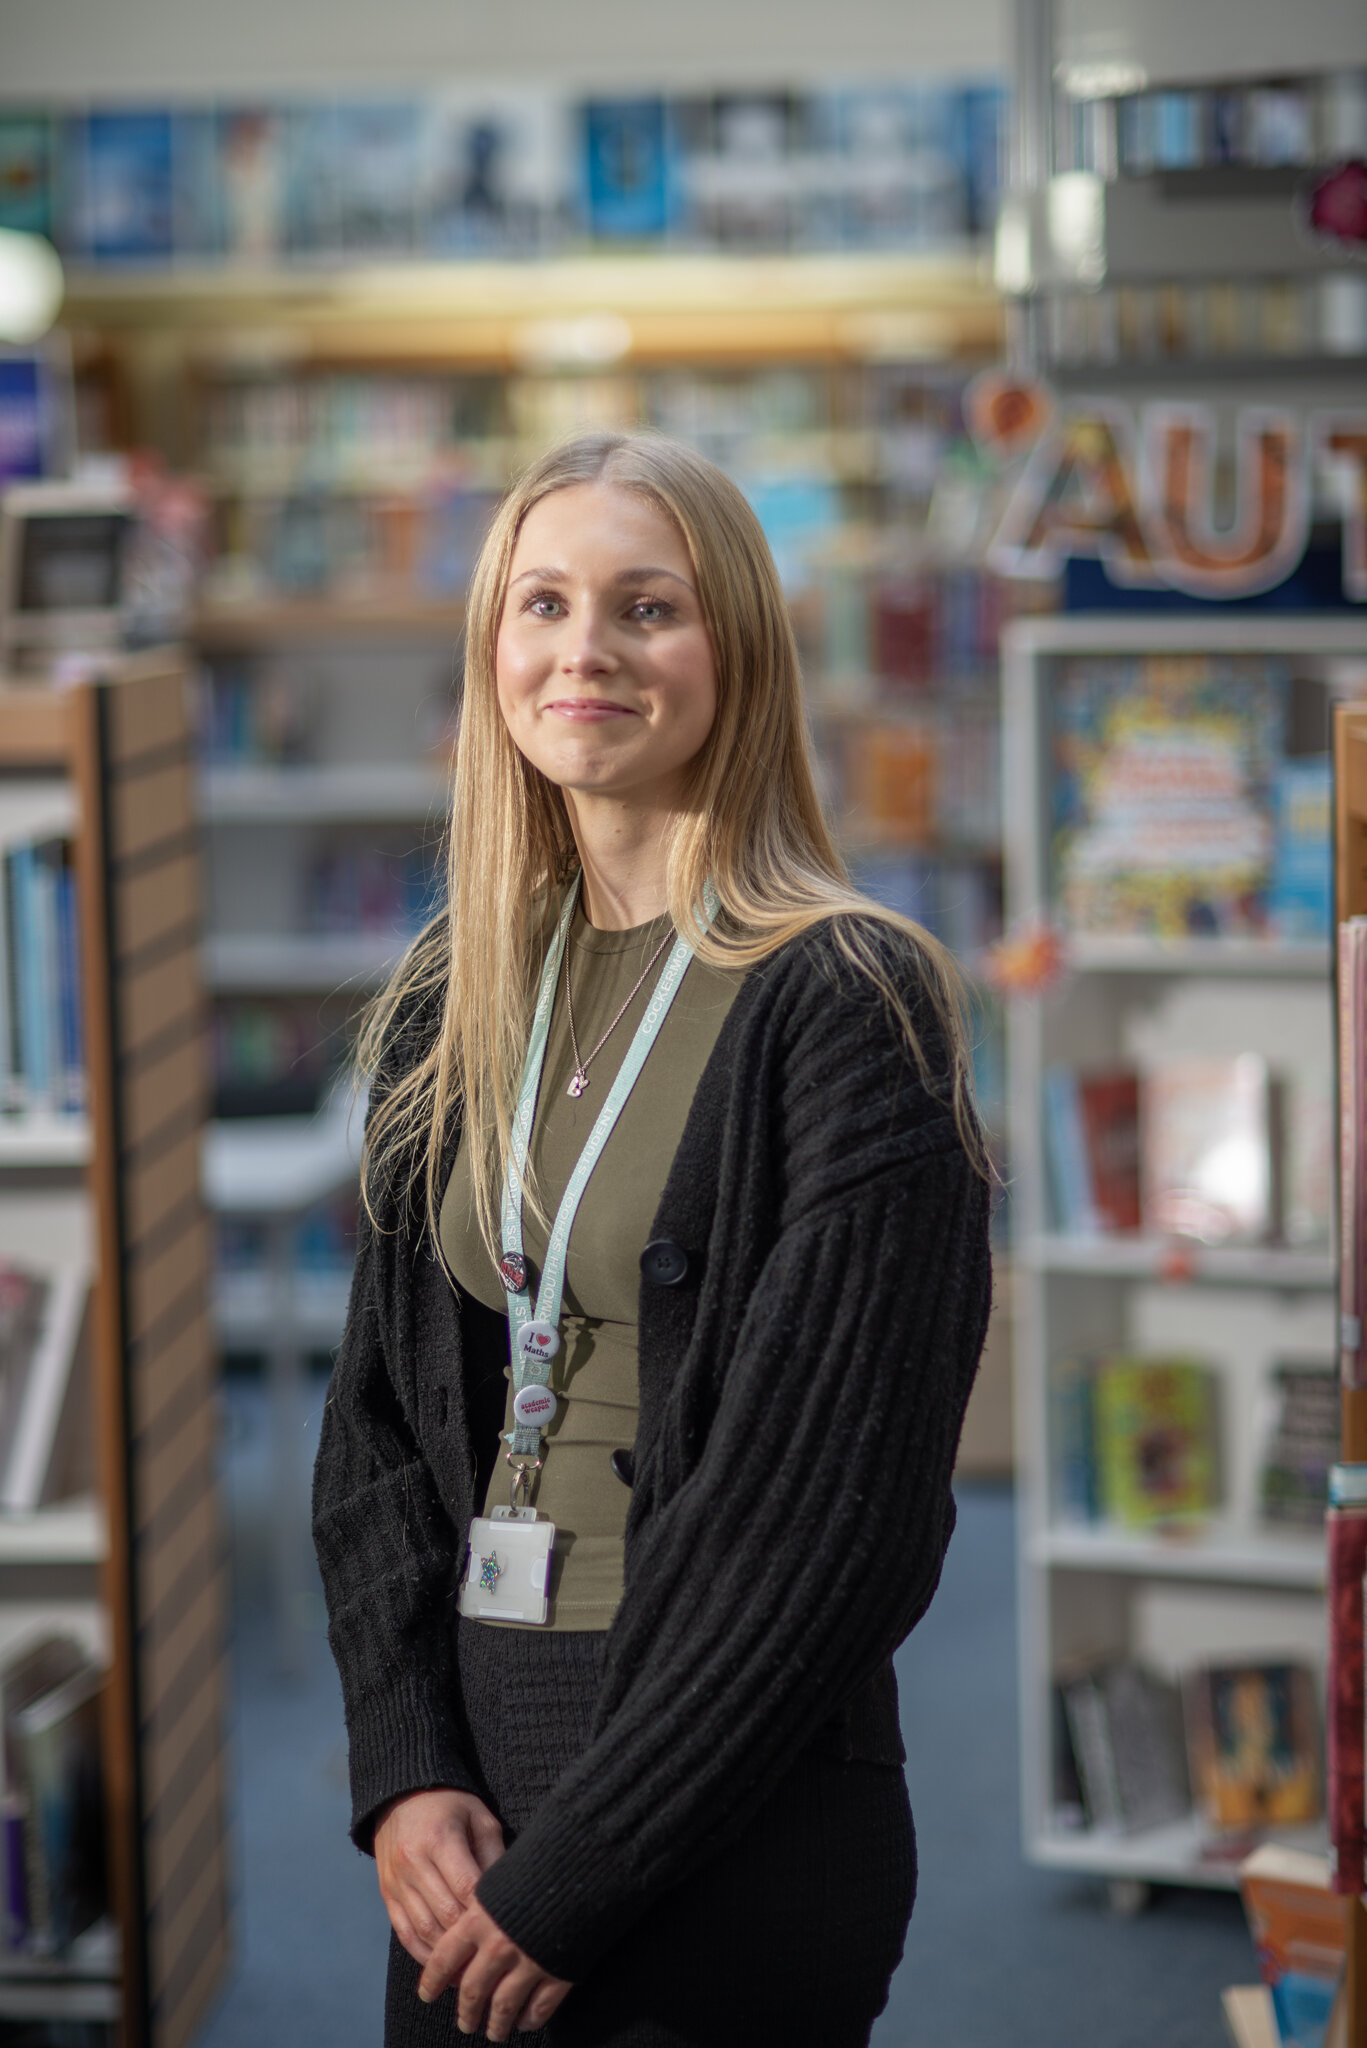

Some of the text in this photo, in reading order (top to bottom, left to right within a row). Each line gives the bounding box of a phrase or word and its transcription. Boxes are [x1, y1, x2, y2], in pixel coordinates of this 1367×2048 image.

[552, 1189, 577, 1254] SCHOOL
[578, 1105, 614, 1176] STUDENT
[528, 1332, 535, 1343] I
[523, 1344, 549, 1358] Maths
[521, 1397, 551, 1409] academic
[524, 1404, 549, 1414] weapon
